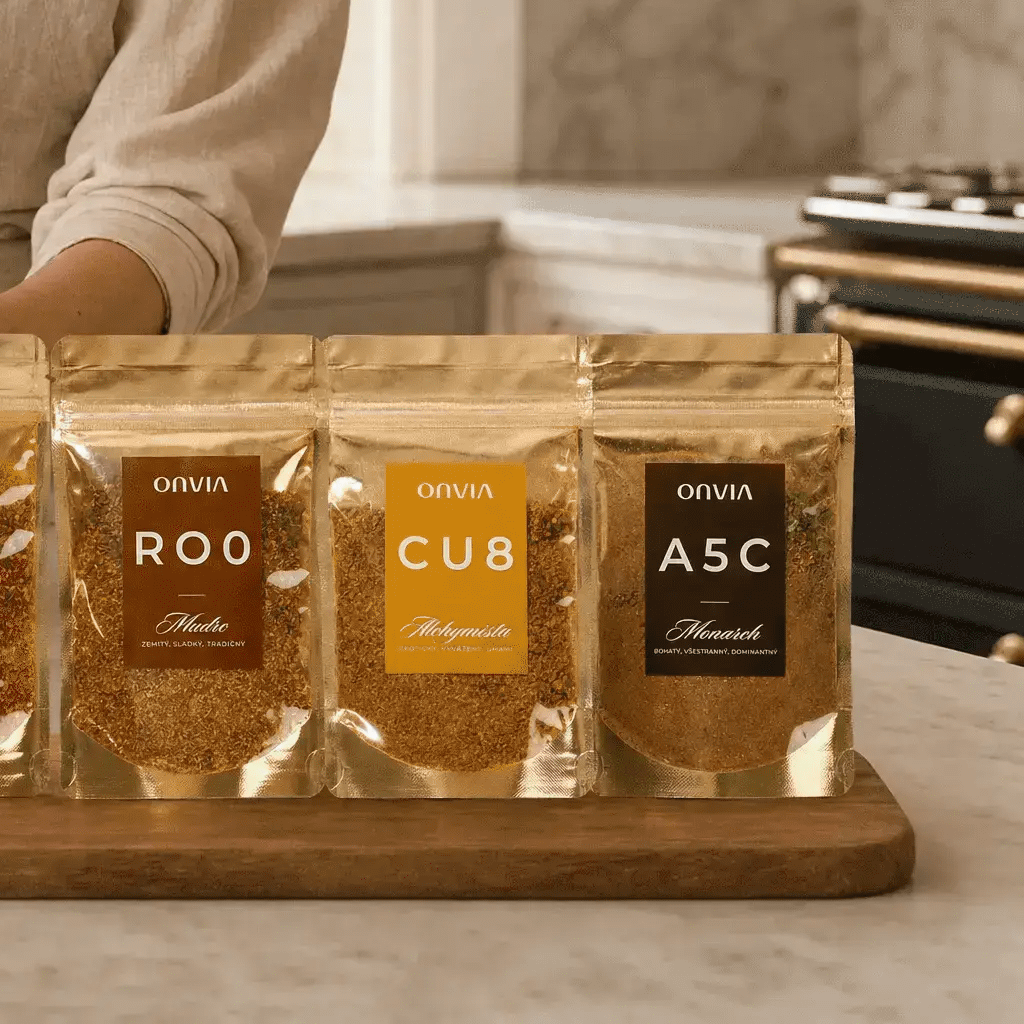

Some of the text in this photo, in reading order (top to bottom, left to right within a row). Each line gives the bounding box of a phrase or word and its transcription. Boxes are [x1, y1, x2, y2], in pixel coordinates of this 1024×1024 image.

[153, 476, 229, 493] ONVIA
[417, 482, 494, 500] ONVIA
[677, 483, 753, 501] ONVIA
[397, 535, 514, 572] CU8
[658, 537, 771, 573] A5C
[665, 618, 764, 642] Monarch
